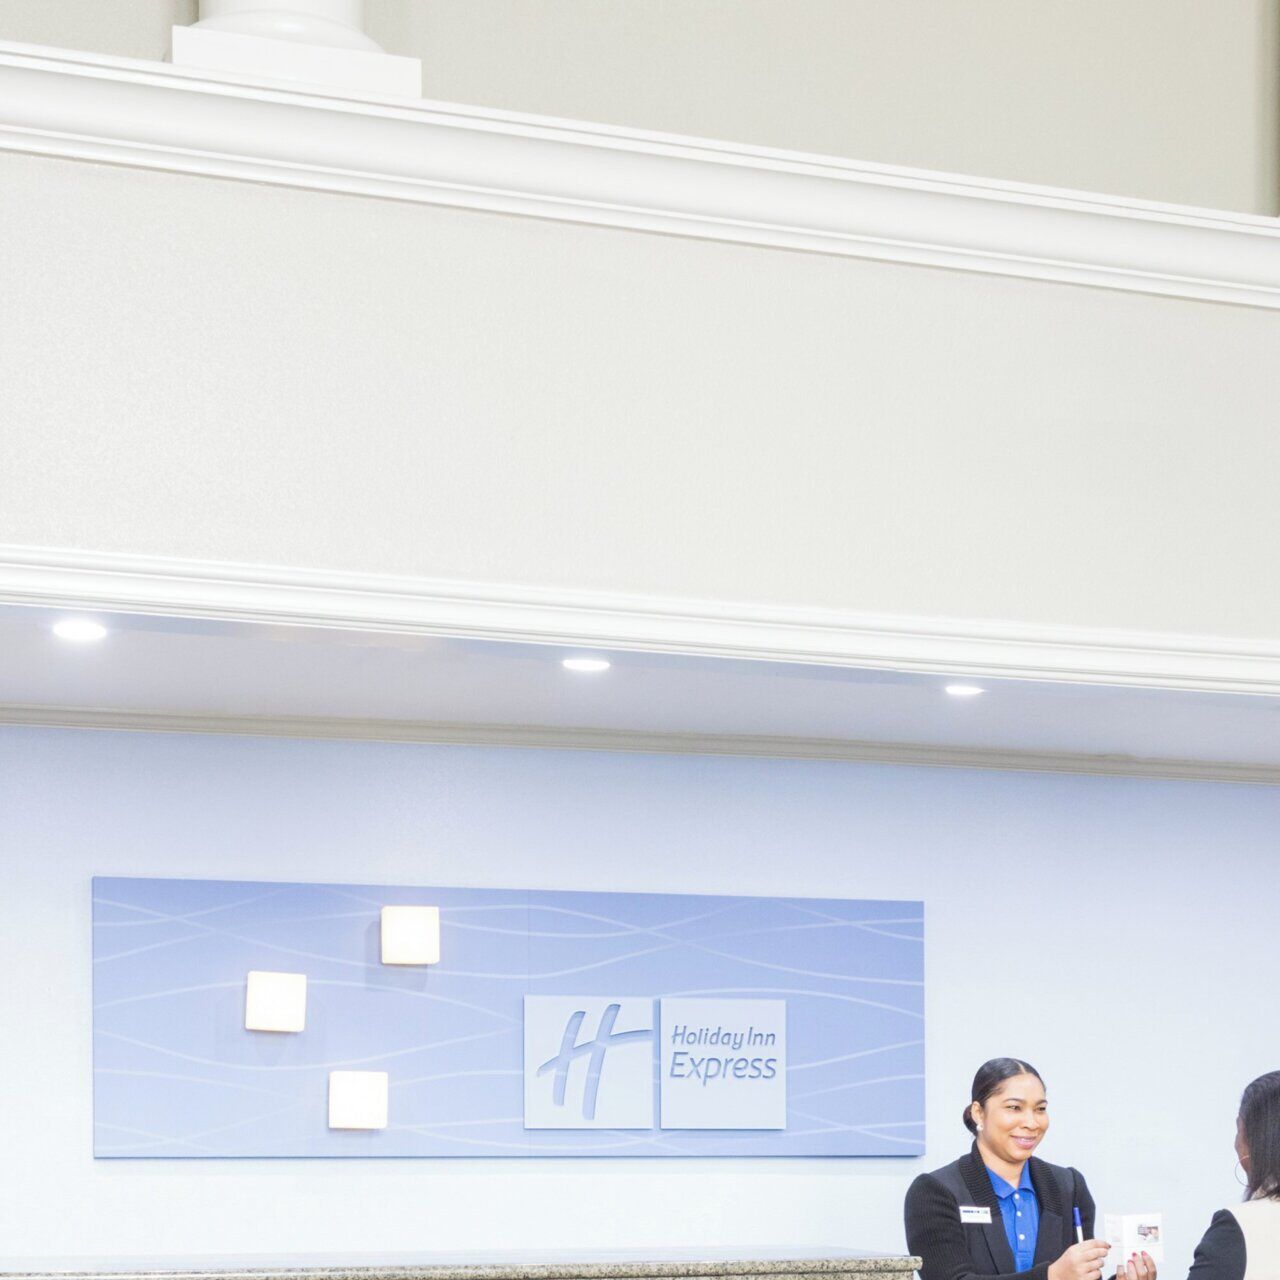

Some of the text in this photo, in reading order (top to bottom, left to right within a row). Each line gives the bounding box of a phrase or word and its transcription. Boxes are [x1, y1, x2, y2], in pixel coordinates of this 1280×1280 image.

[671, 1025, 776, 1050] Holiday Inn
[669, 1051, 778, 1086] Express
